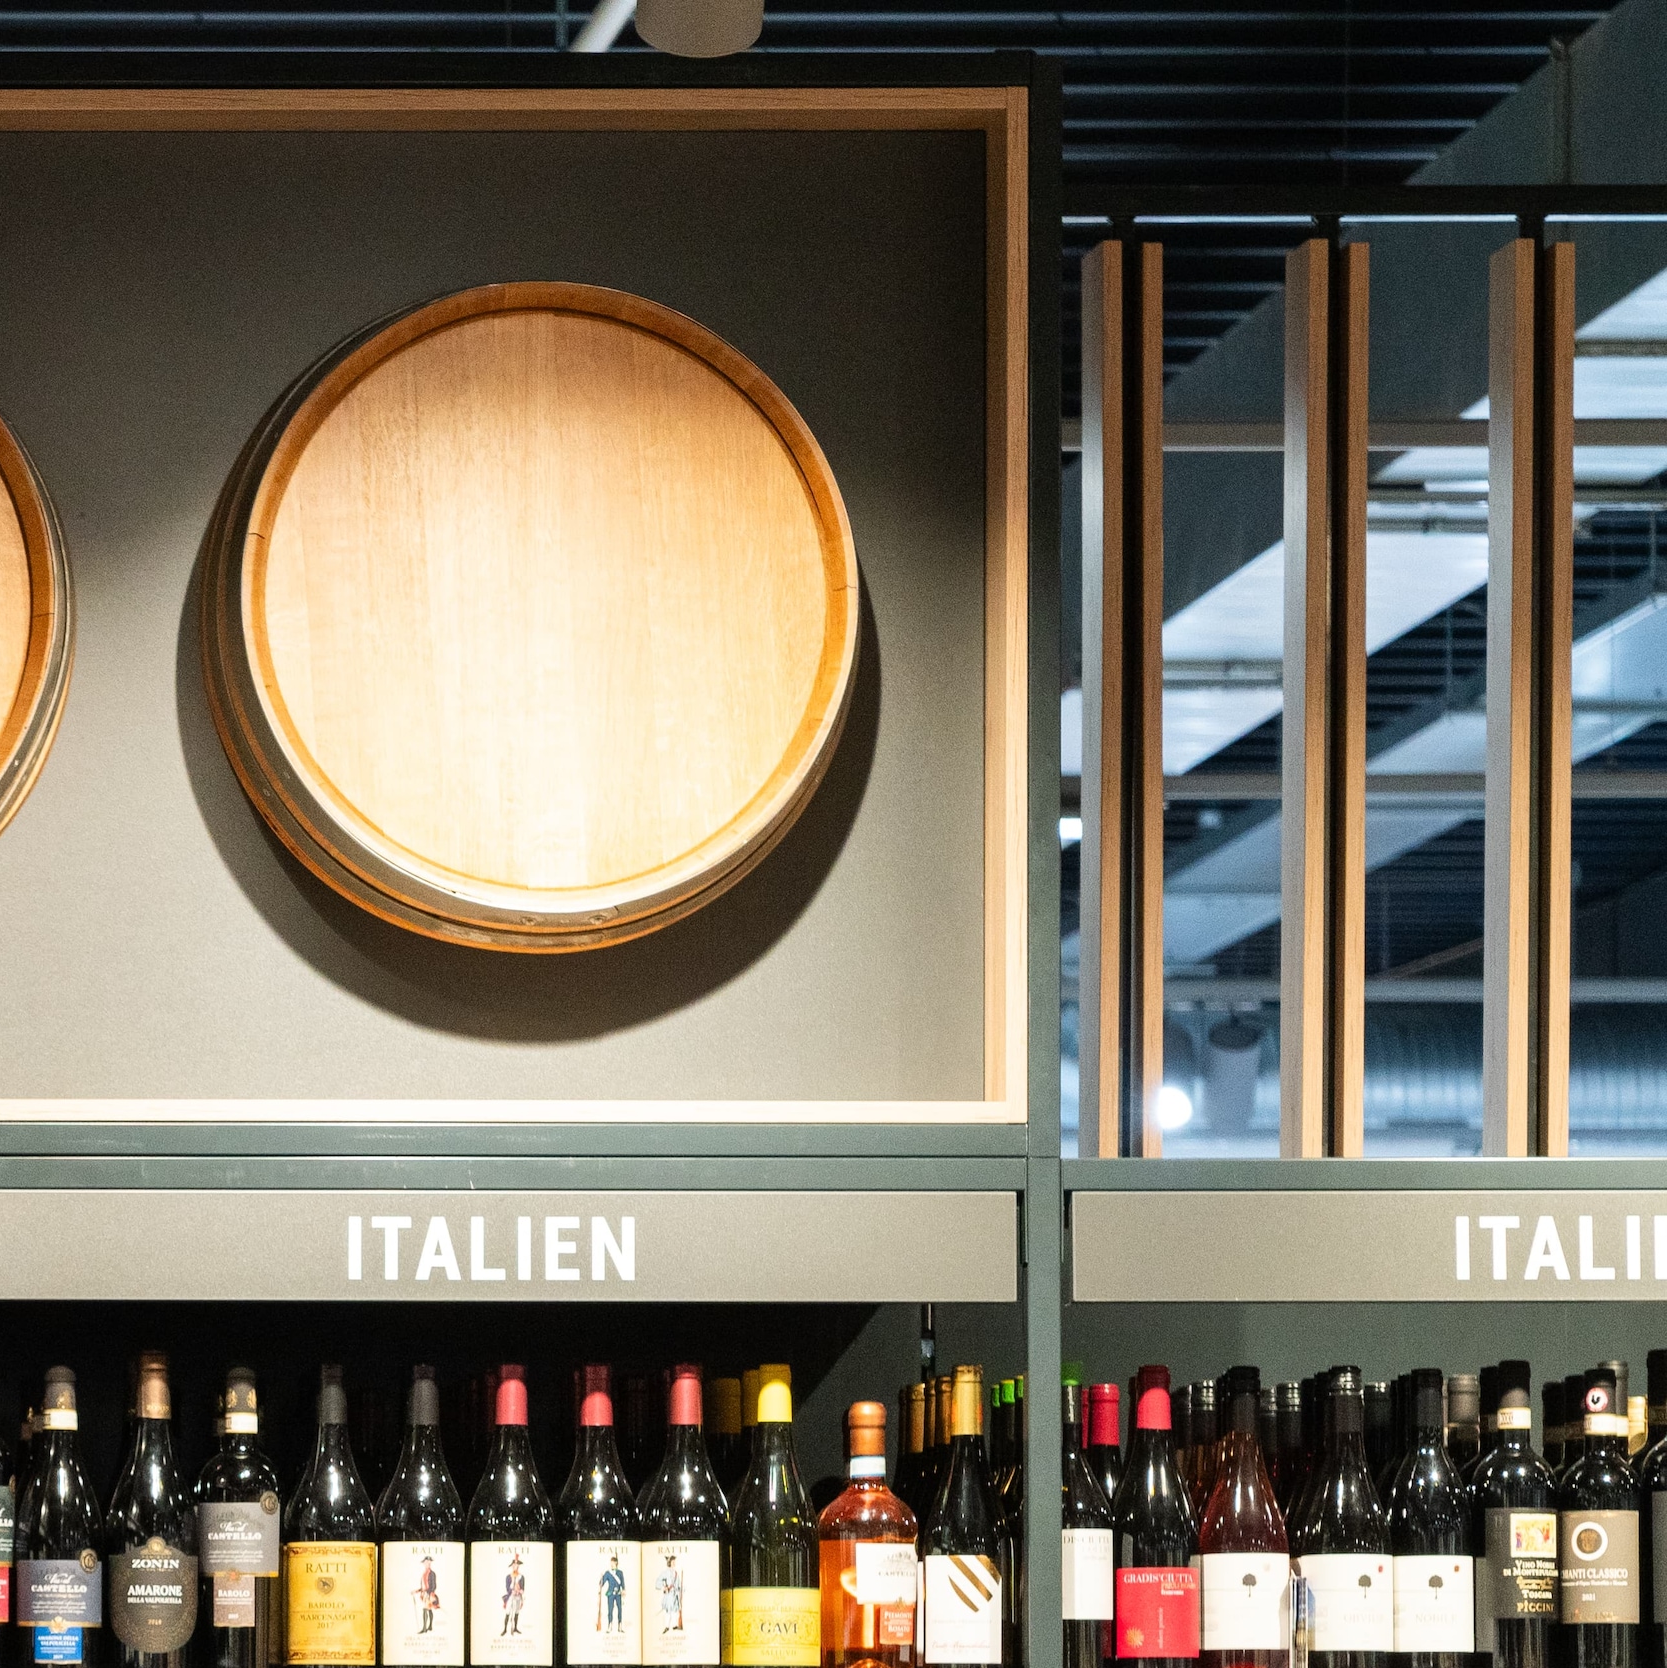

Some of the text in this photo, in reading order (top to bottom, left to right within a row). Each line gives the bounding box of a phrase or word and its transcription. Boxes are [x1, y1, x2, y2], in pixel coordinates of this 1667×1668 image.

[348, 1216, 636, 1281] ITALIEN
[132, 1559, 179, 1568] ZONIN
[305, 1563, 347, 1573] RATTI
[1124, 1574, 1193, 1583] GRADIS'CIUTTA
[1587, 1568, 1628, 1579] CLASSICO
[128, 1585, 182, 1596] AMARONE
[1517, 1601, 1554, 1612] PICCINI
[760, 1622, 798, 1634] GAVI
